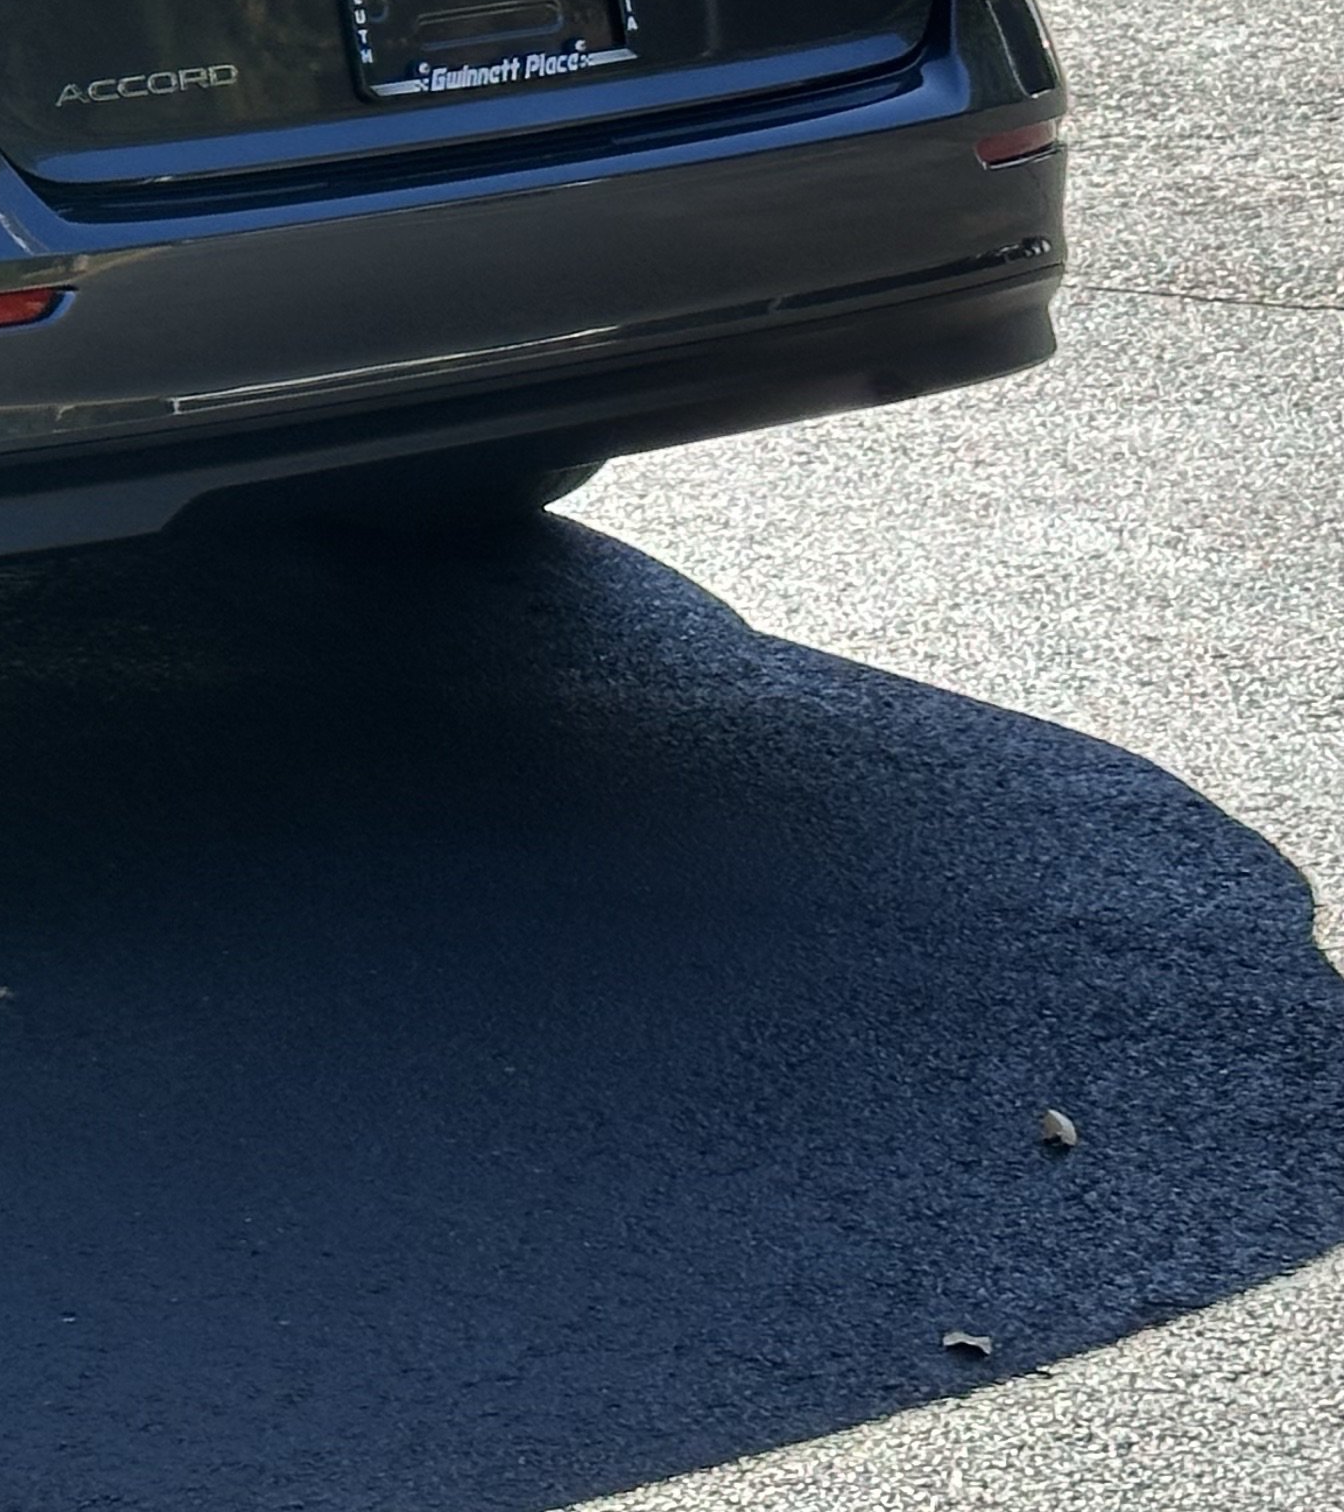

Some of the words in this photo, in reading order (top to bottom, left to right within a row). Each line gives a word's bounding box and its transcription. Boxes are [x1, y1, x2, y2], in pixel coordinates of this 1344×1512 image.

[55, 63, 239, 107] ACCORD
[430, 56, 521, 92] Gwinnett
[525, 52, 580, 80] Place
